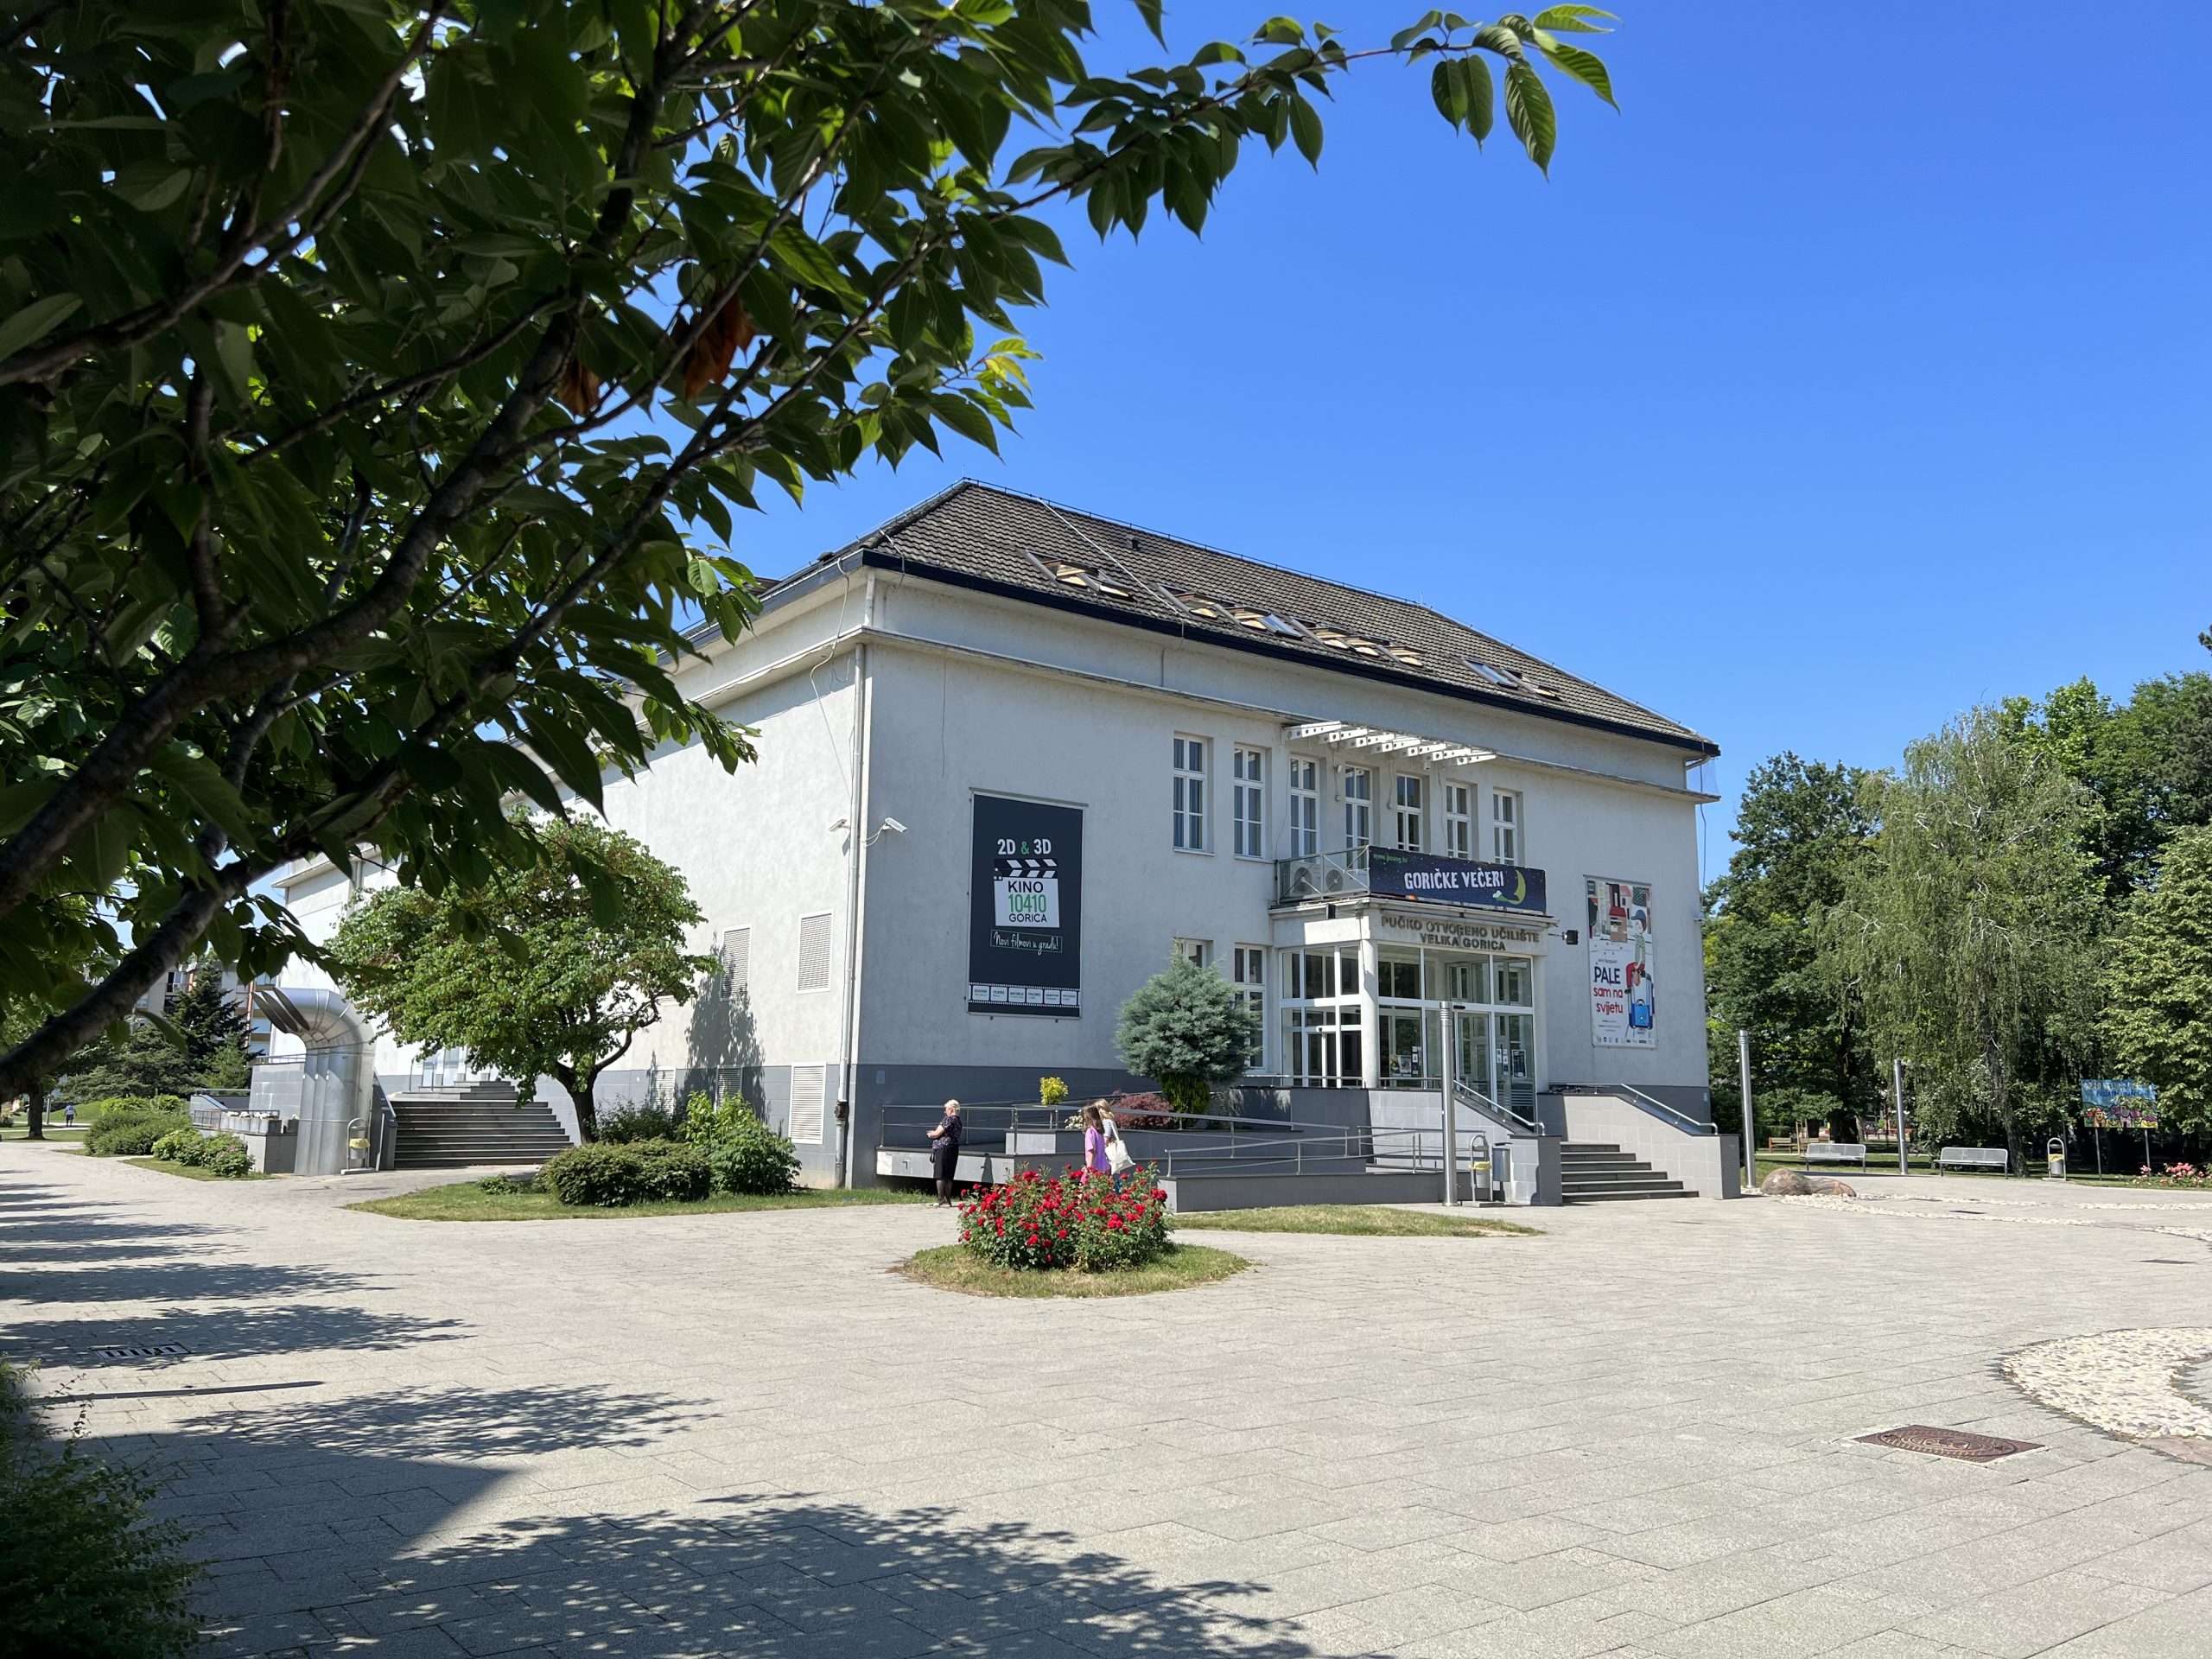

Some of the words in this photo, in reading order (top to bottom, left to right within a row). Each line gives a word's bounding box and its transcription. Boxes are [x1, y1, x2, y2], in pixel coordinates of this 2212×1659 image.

[997, 838, 1016, 855] 2D
[1020, 841, 1030, 855] &
[1033, 838, 1052, 855] 3D
[1007, 880, 1044, 893] KINO
[1404, 868, 1459, 890] GORIČKE
[1461, 868, 1504, 888] VEČERI
[1007, 893, 1047, 913] 10410
[1008, 913, 1047, 923] GORICA
[1382, 915, 1423, 931] PUČKO
[1427, 921, 1488, 938] OTVORENO
[1491, 926, 1540, 944] UČILIŠTE
[994, 931, 1009, 946] Novi
[1011, 933, 1032, 949] filmovi
[1033, 940, 1037, 949] u
[1038, 936, 1058, 956] gradu!
[1420, 932, 1460, 947] VELIKA
[1463, 938, 1506, 950] GORICA
[1593, 966, 1621, 984] PALE
[1593, 987, 1611, 997] sam
[1612, 988, 1623, 998] na
[1596, 1001, 1623, 1015] svijetu
